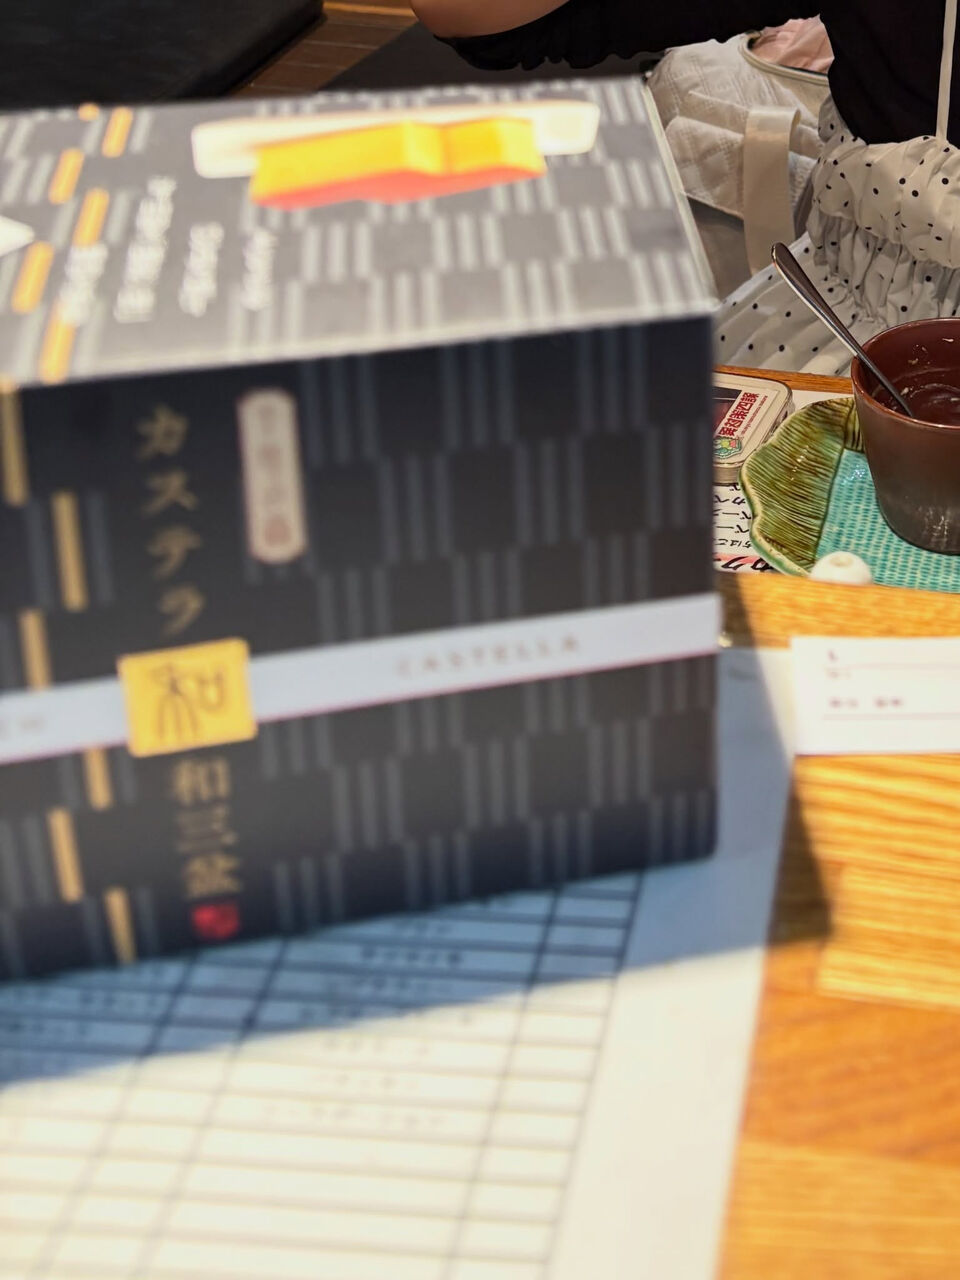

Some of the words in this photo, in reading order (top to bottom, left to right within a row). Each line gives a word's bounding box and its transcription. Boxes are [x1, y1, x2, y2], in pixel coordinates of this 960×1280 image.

[137, 403, 206, 638] カステラ
[400, 631, 584, 679] CASTELLA
